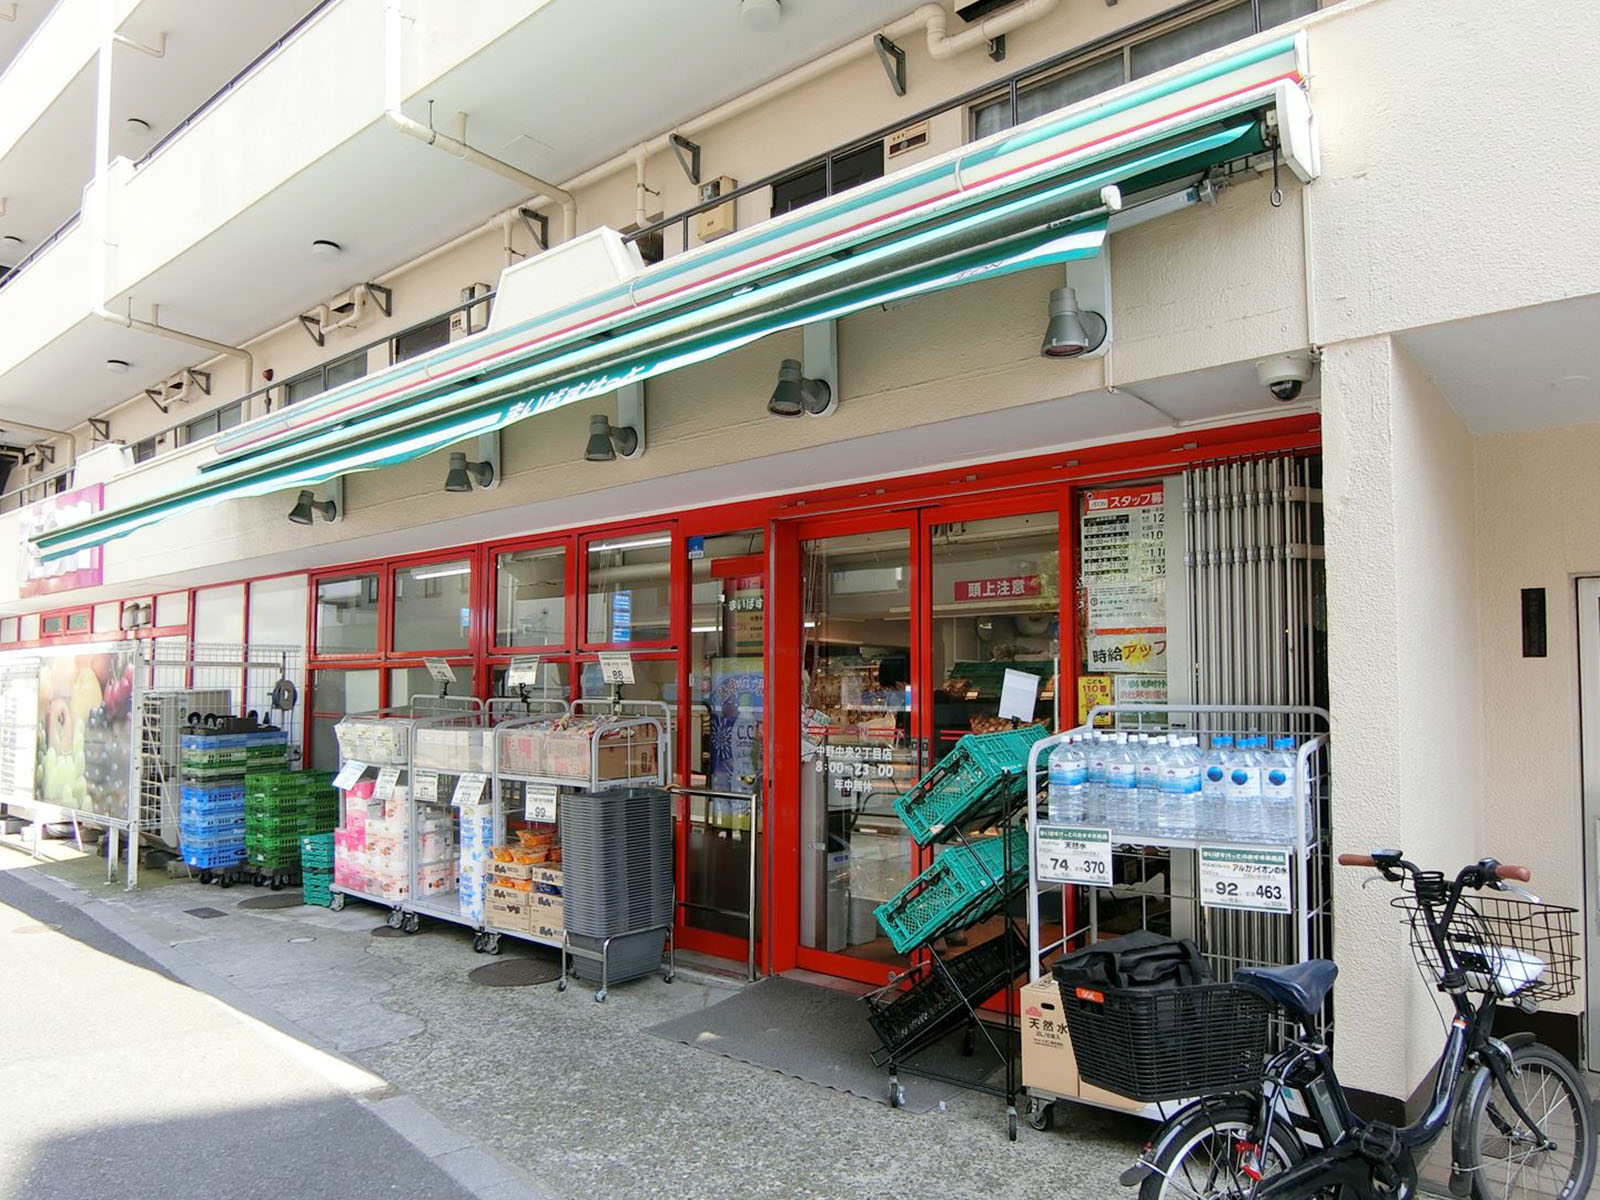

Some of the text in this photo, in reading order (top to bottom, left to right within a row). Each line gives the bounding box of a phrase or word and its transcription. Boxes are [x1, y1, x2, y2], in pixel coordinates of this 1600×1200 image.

[968, 579, 1025, 598] 頭上注意
[816, 745, 892, 760] 中野中央2丁目店
[834, 778, 873, 793] 年中無休
[1064, 841, 1087, 849] 天然水
[1050, 857, 1069, 871] 74
[1083, 860, 1105, 874] 370
[1232, 863, 1288, 875] アルカリイオンの水
[1215, 881, 1239, 896] 92
[1255, 884, 1282, 900] 463
[1028, 1017, 1068, 1034] 天然水
